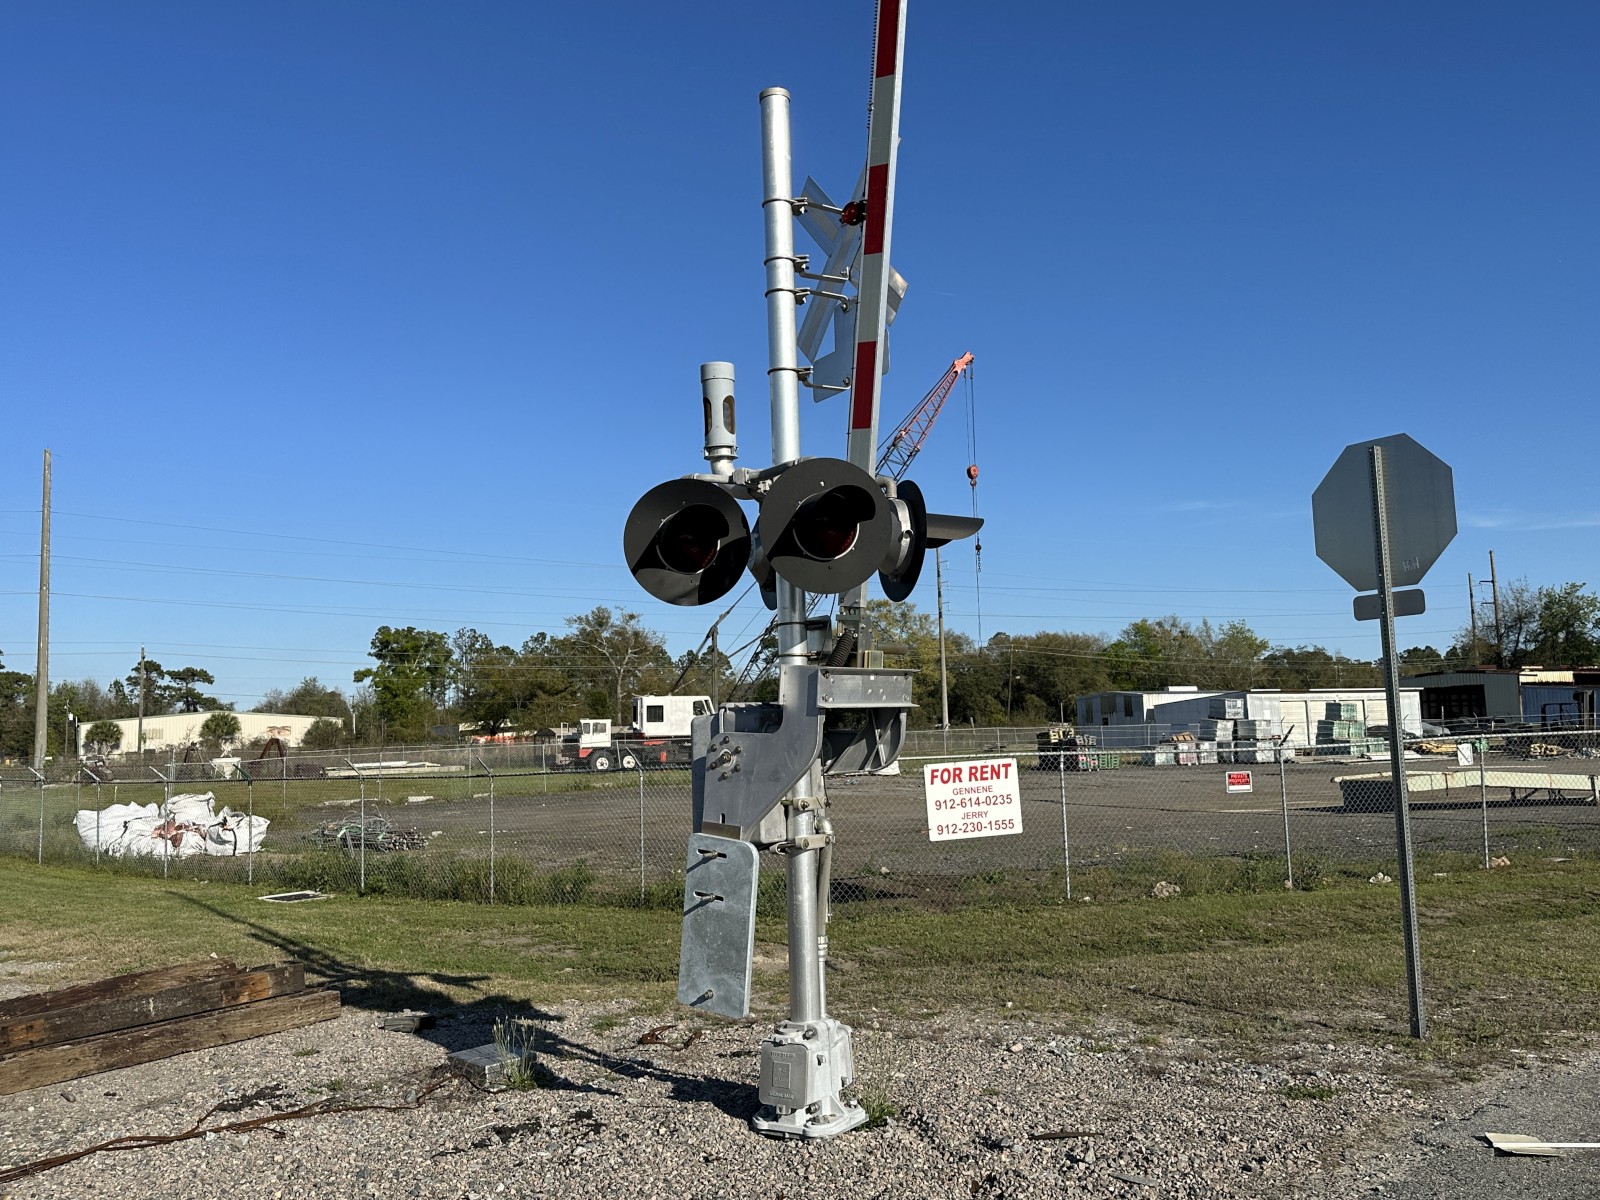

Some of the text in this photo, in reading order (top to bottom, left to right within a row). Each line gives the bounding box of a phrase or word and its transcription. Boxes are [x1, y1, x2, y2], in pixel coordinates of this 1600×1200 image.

[930, 763, 1012, 785] FOR RENT
[952, 785, 993, 796] GENNENE
[935, 794, 1012, 810] 912-614-0235
[961, 811, 988, 820] JERRY
[937, 819, 1014, 835] 912-230-1555
